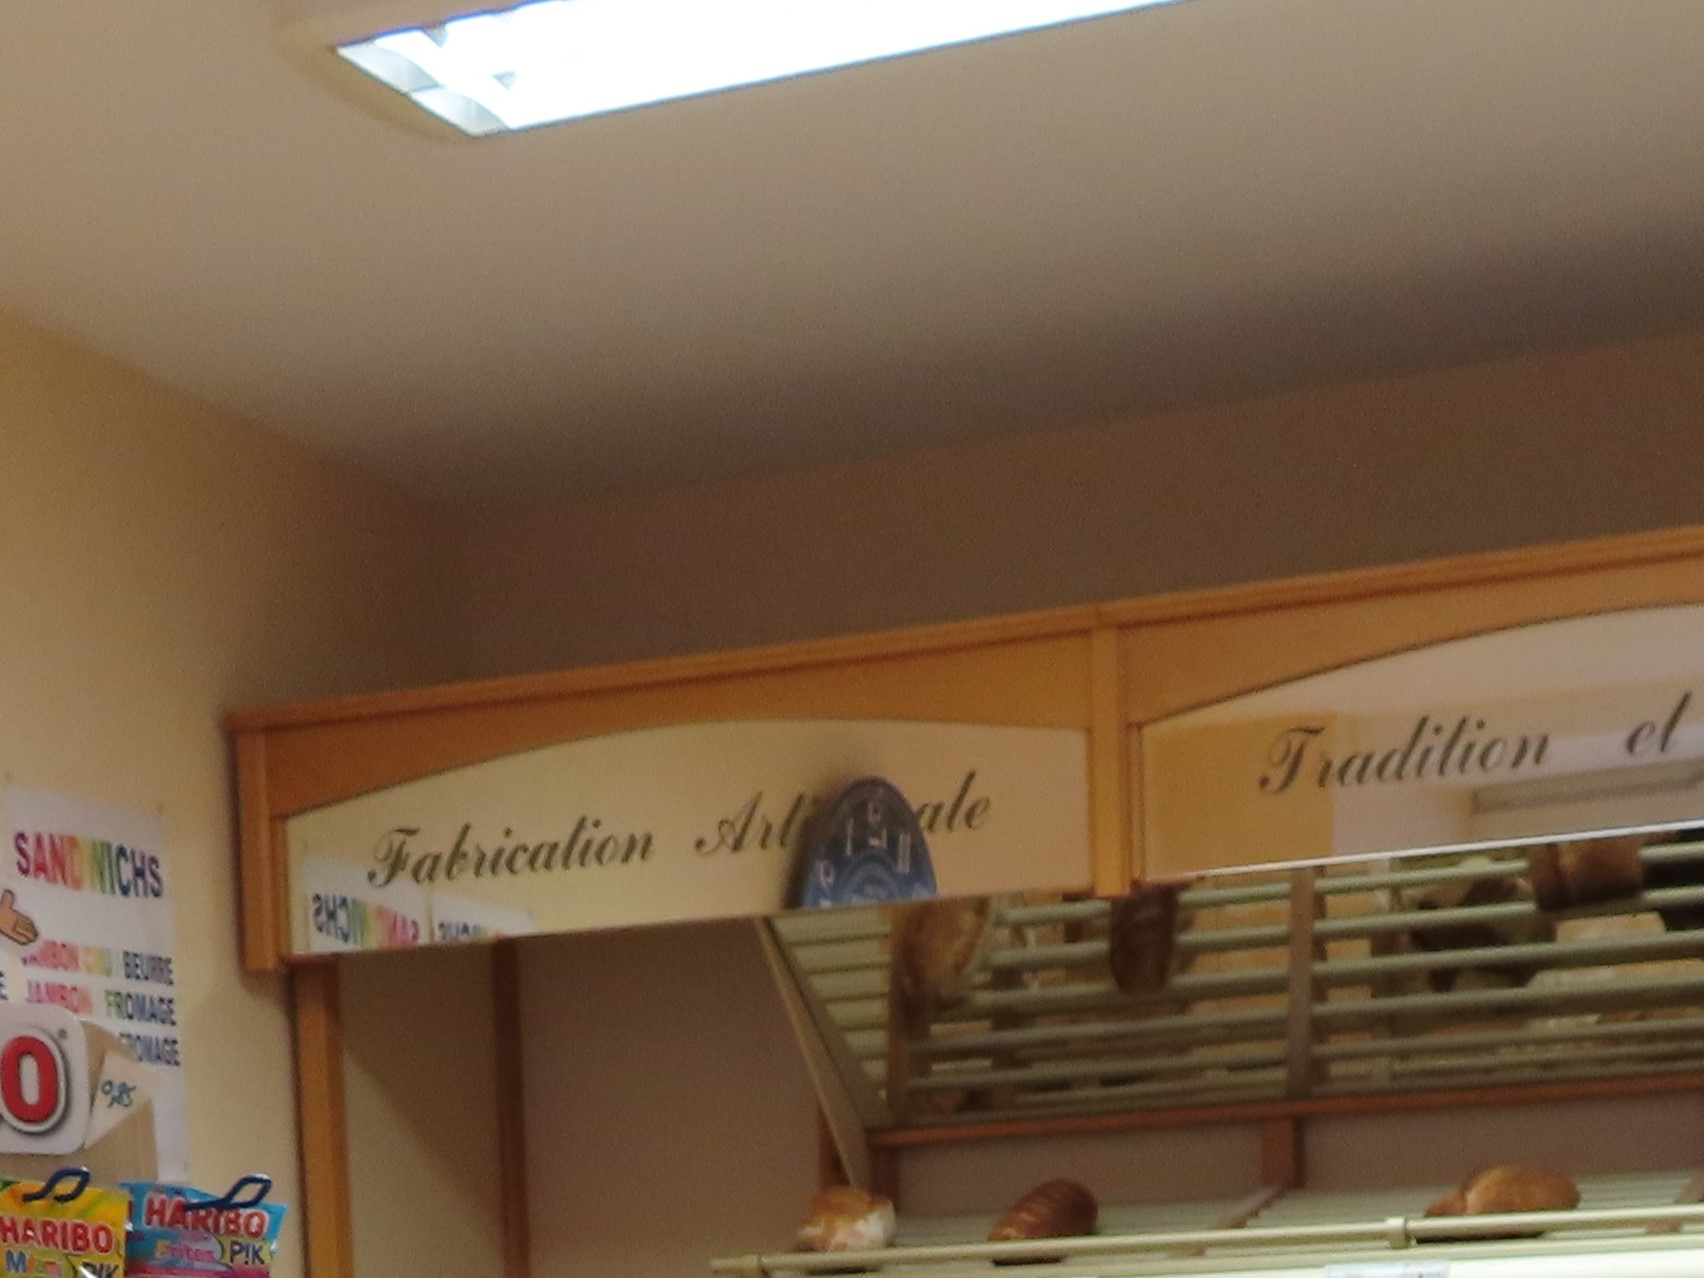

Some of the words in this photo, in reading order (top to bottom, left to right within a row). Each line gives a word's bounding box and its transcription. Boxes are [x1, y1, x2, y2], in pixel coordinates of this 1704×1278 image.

[1256, 713, 1553, 796] Tradition
[1624, 690, 1694, 756] et
[14, 831, 163, 898] SANDWICHS
[367, 815, 656, 890] Fabrication
[144, 1193, 268, 1237] HARIBO
